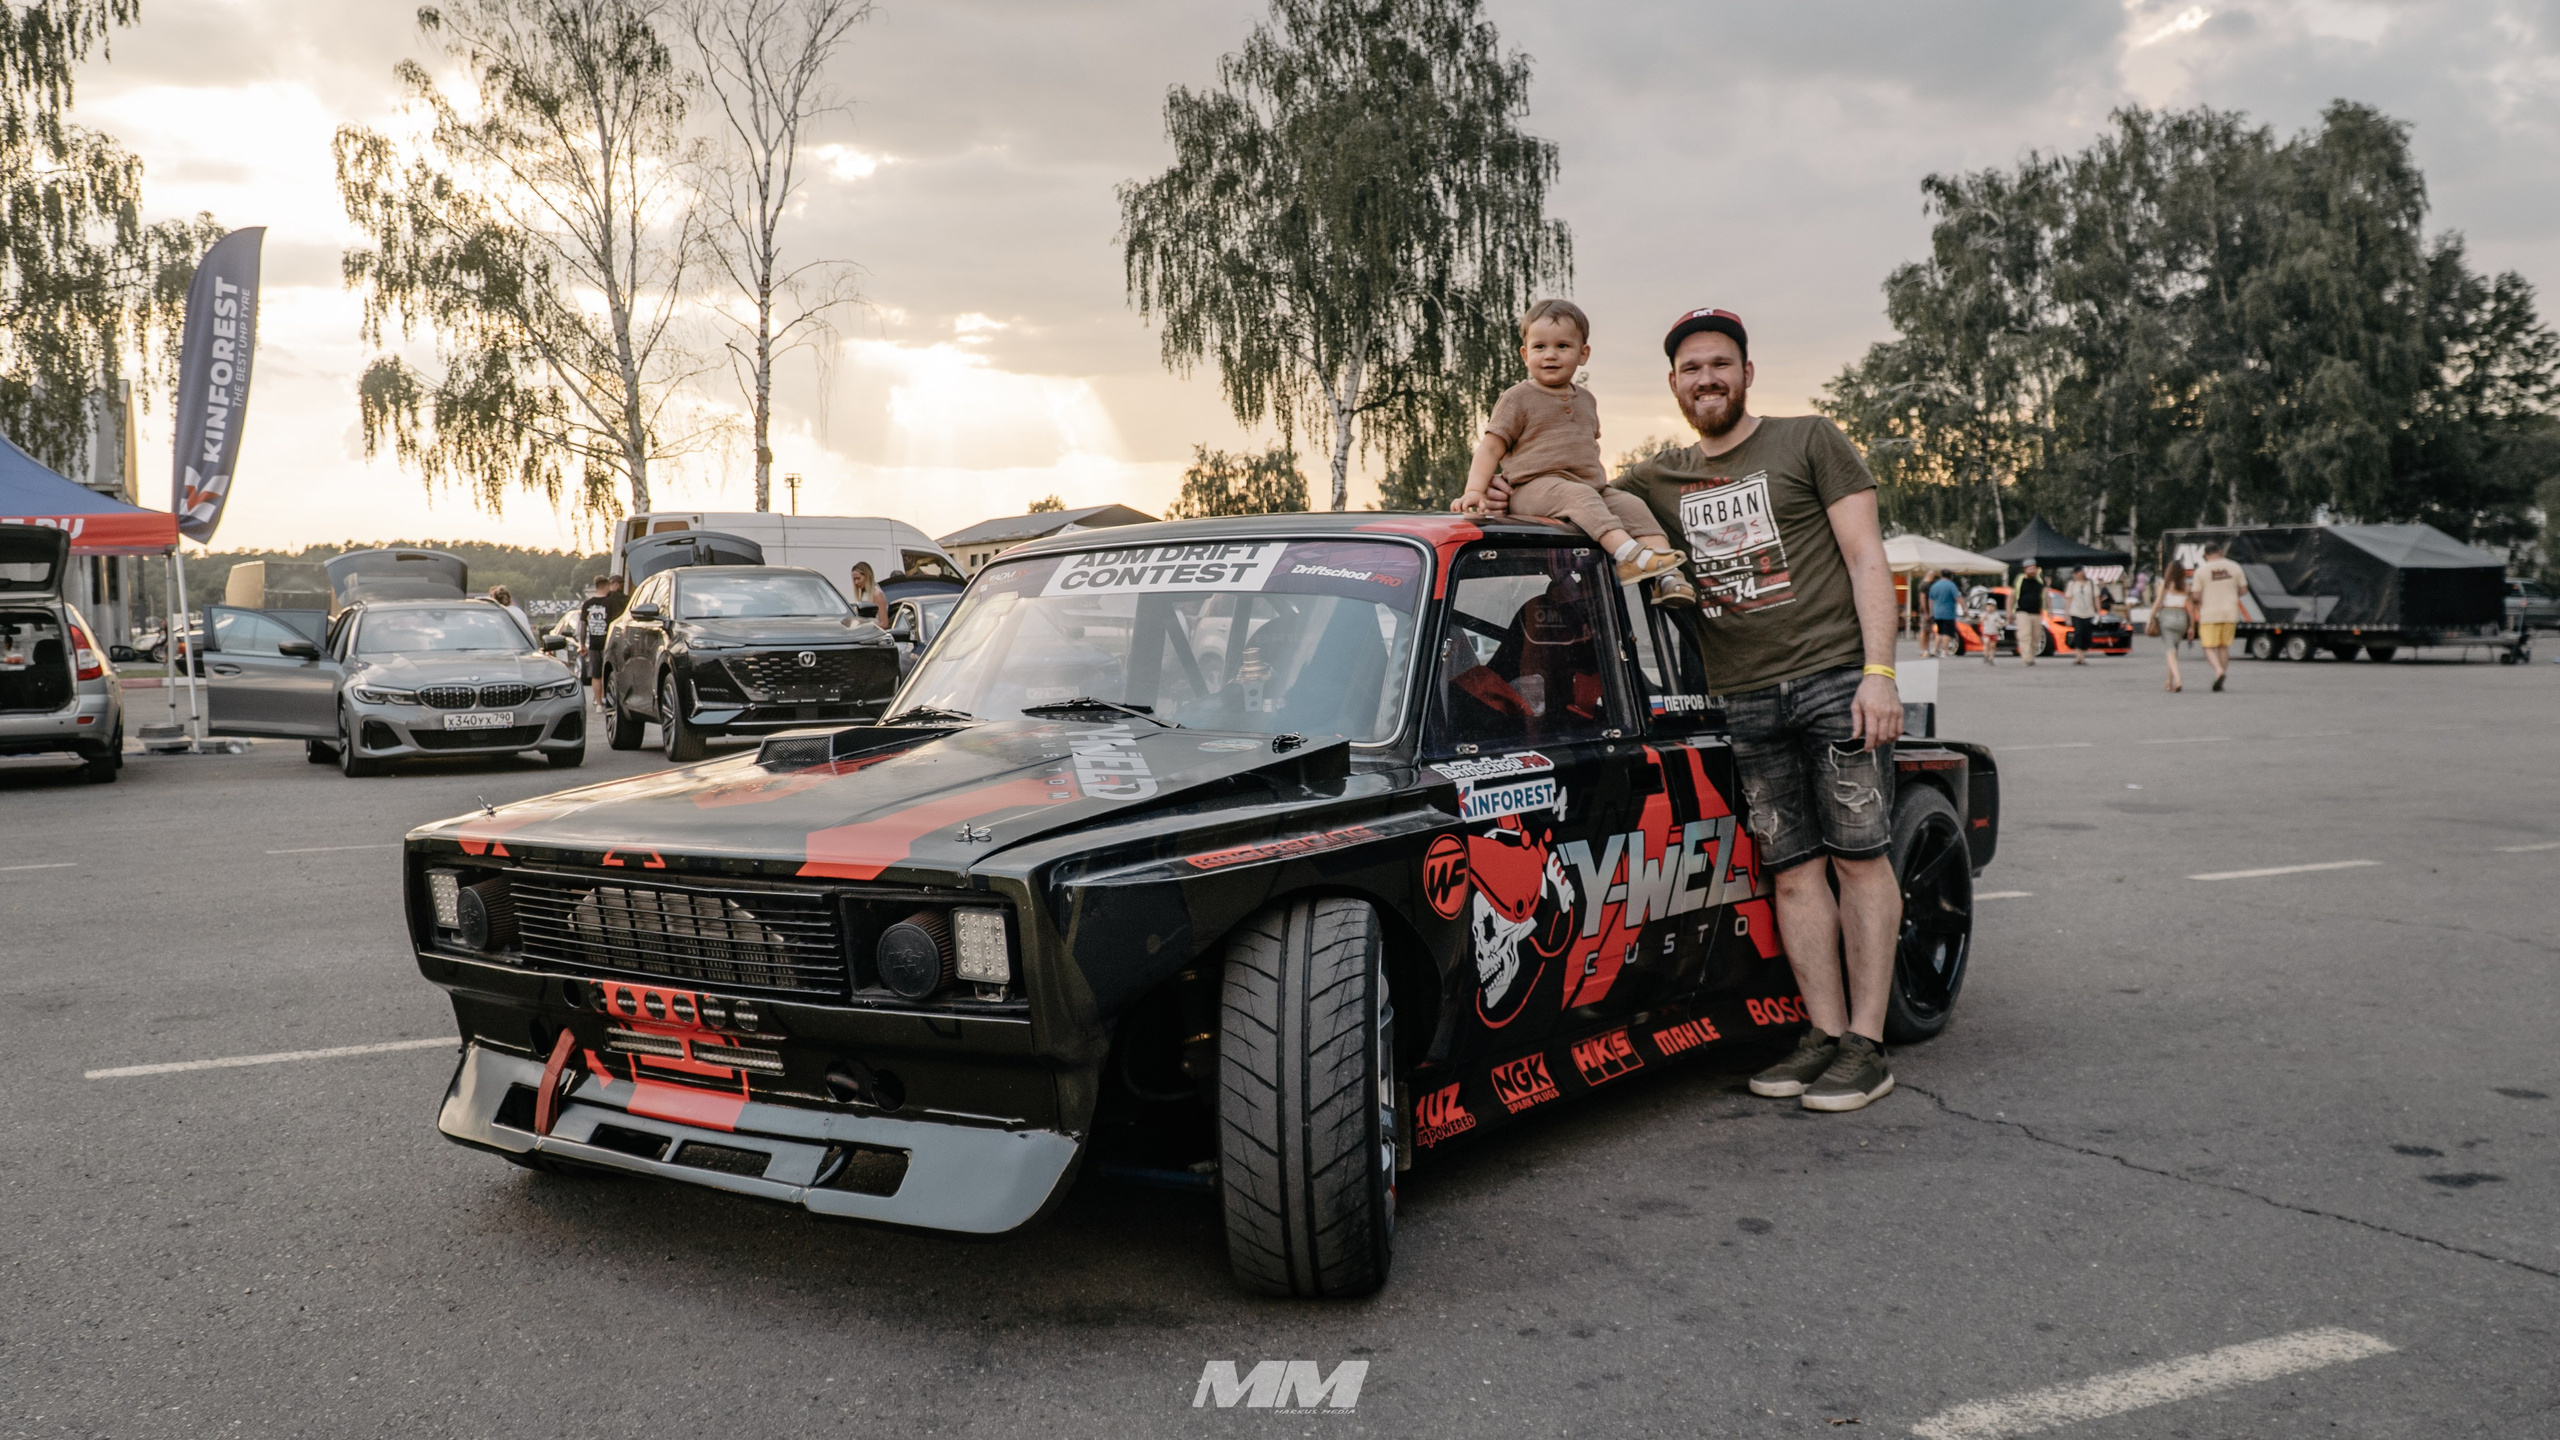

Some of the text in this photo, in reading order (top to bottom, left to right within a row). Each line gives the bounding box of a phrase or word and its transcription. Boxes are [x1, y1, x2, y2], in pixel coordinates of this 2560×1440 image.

[231, 287, 251, 408] THE BEST UHP TYRE
[202, 276, 238, 464] KINFOREST
[1689, 491, 1759, 528] URBAN
[1071, 543, 1271, 570] ADM DRIFT
[1060, 562, 1259, 591] CONTEST
[1663, 694, 1705, 712] ПЕТРОВ
[1457, 783, 1554, 818] KINFOREST
[1584, 916, 1749, 976] CUSTO
[1746, 996, 1811, 1026] BOSC
[1573, 1030, 1633, 1072] HKS
[1652, 1016, 1722, 1056] MAHLE
[1493, 1054, 1552, 1103] NGK
[1415, 1082, 1467, 1127] 1UZ
[1507, 1086, 1561, 1115] SPARK PLUGS
